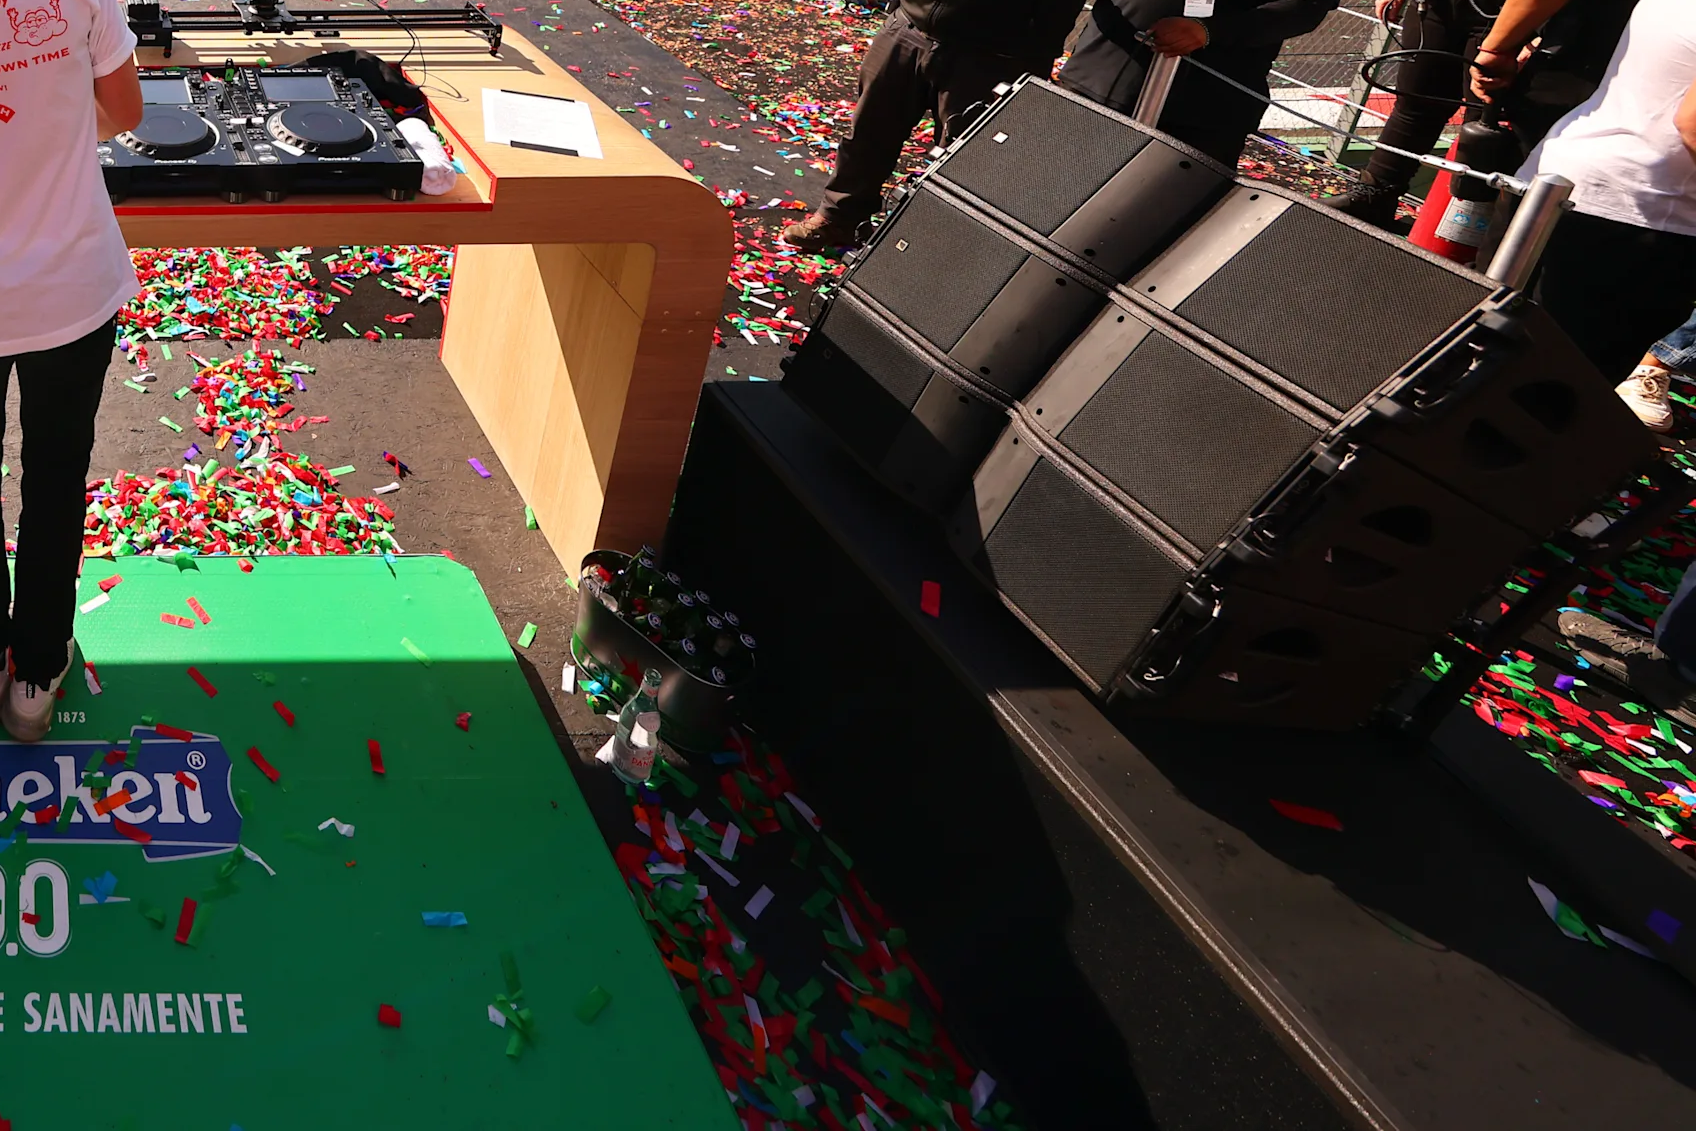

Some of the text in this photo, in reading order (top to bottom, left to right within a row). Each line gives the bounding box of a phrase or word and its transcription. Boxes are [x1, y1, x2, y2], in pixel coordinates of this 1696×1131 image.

[32, 47, 70, 66] TIME
[57, 711, 86, 723] 1873
[23, 991, 248, 1033] SANAMENTE
